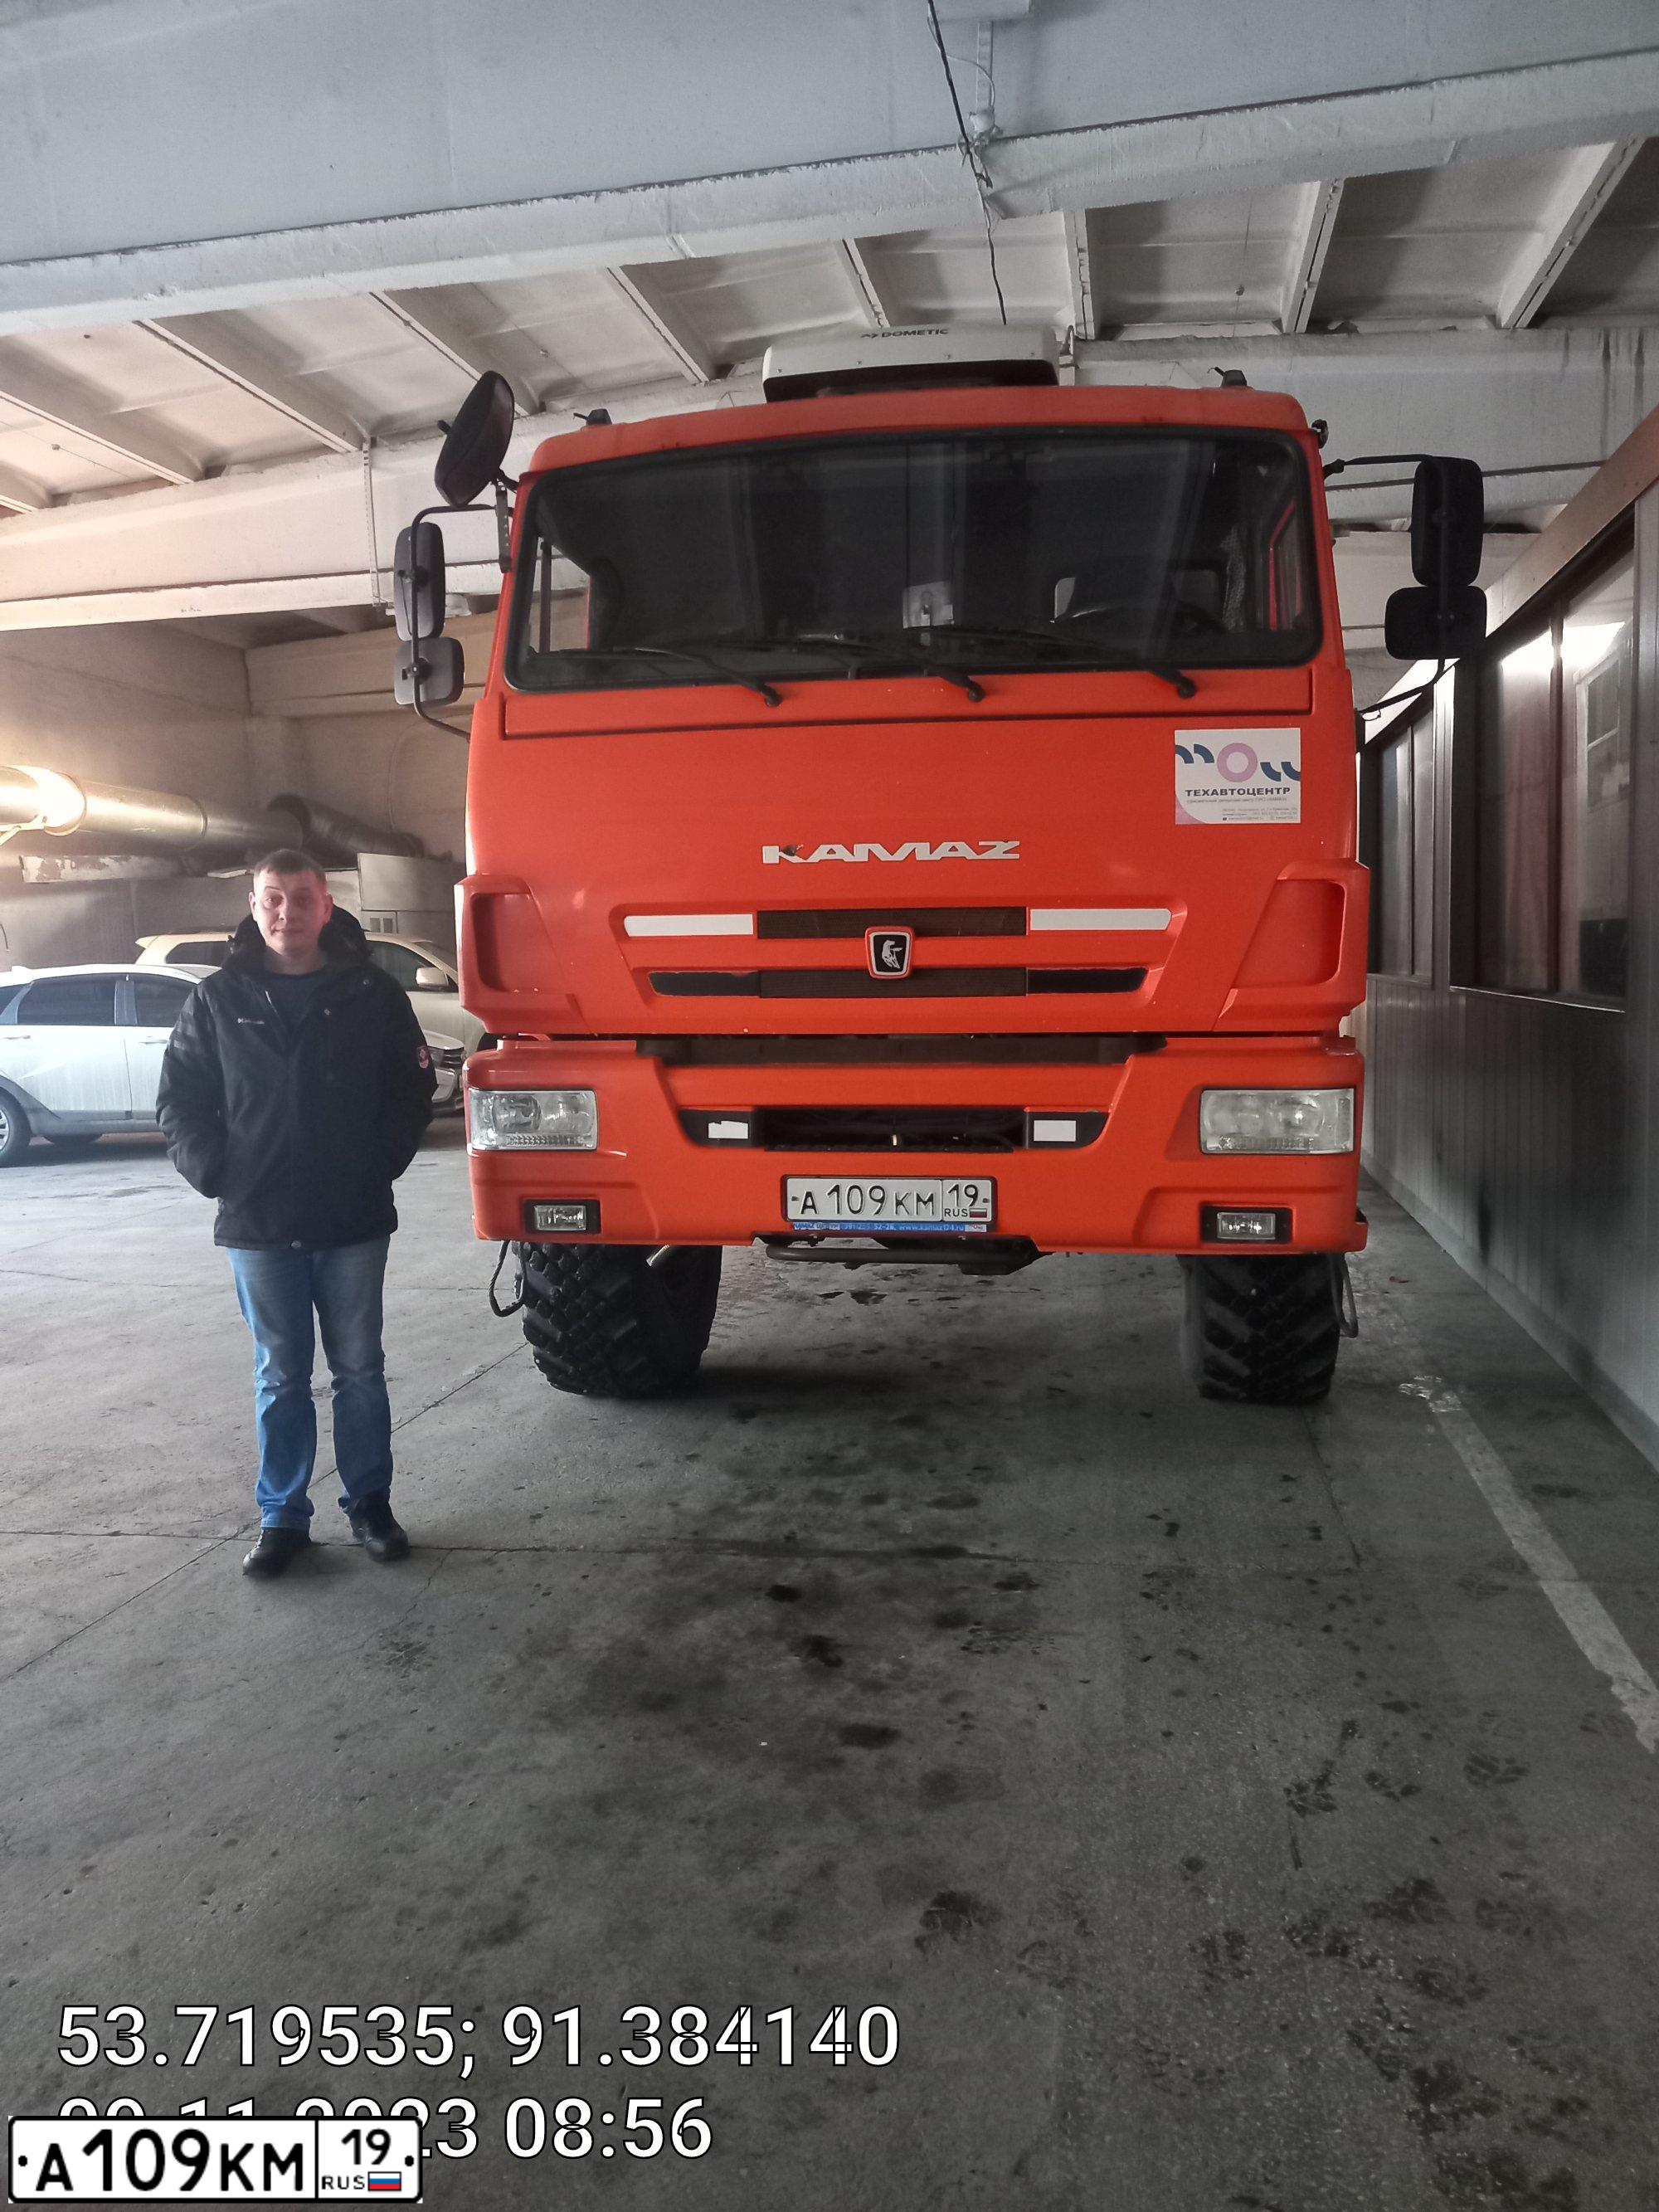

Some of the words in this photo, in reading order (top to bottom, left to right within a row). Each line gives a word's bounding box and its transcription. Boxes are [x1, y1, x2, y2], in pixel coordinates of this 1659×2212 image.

[881, 329, 948, 338] DOMETIC
[1185, 787, 1291, 797] ТЕХАВТОЦЕНТР
[762, 840, 1019, 864] KAMAZ
[947, 1184, 979, 1207] 19
[944, 1208, 968, 1217] RUS
